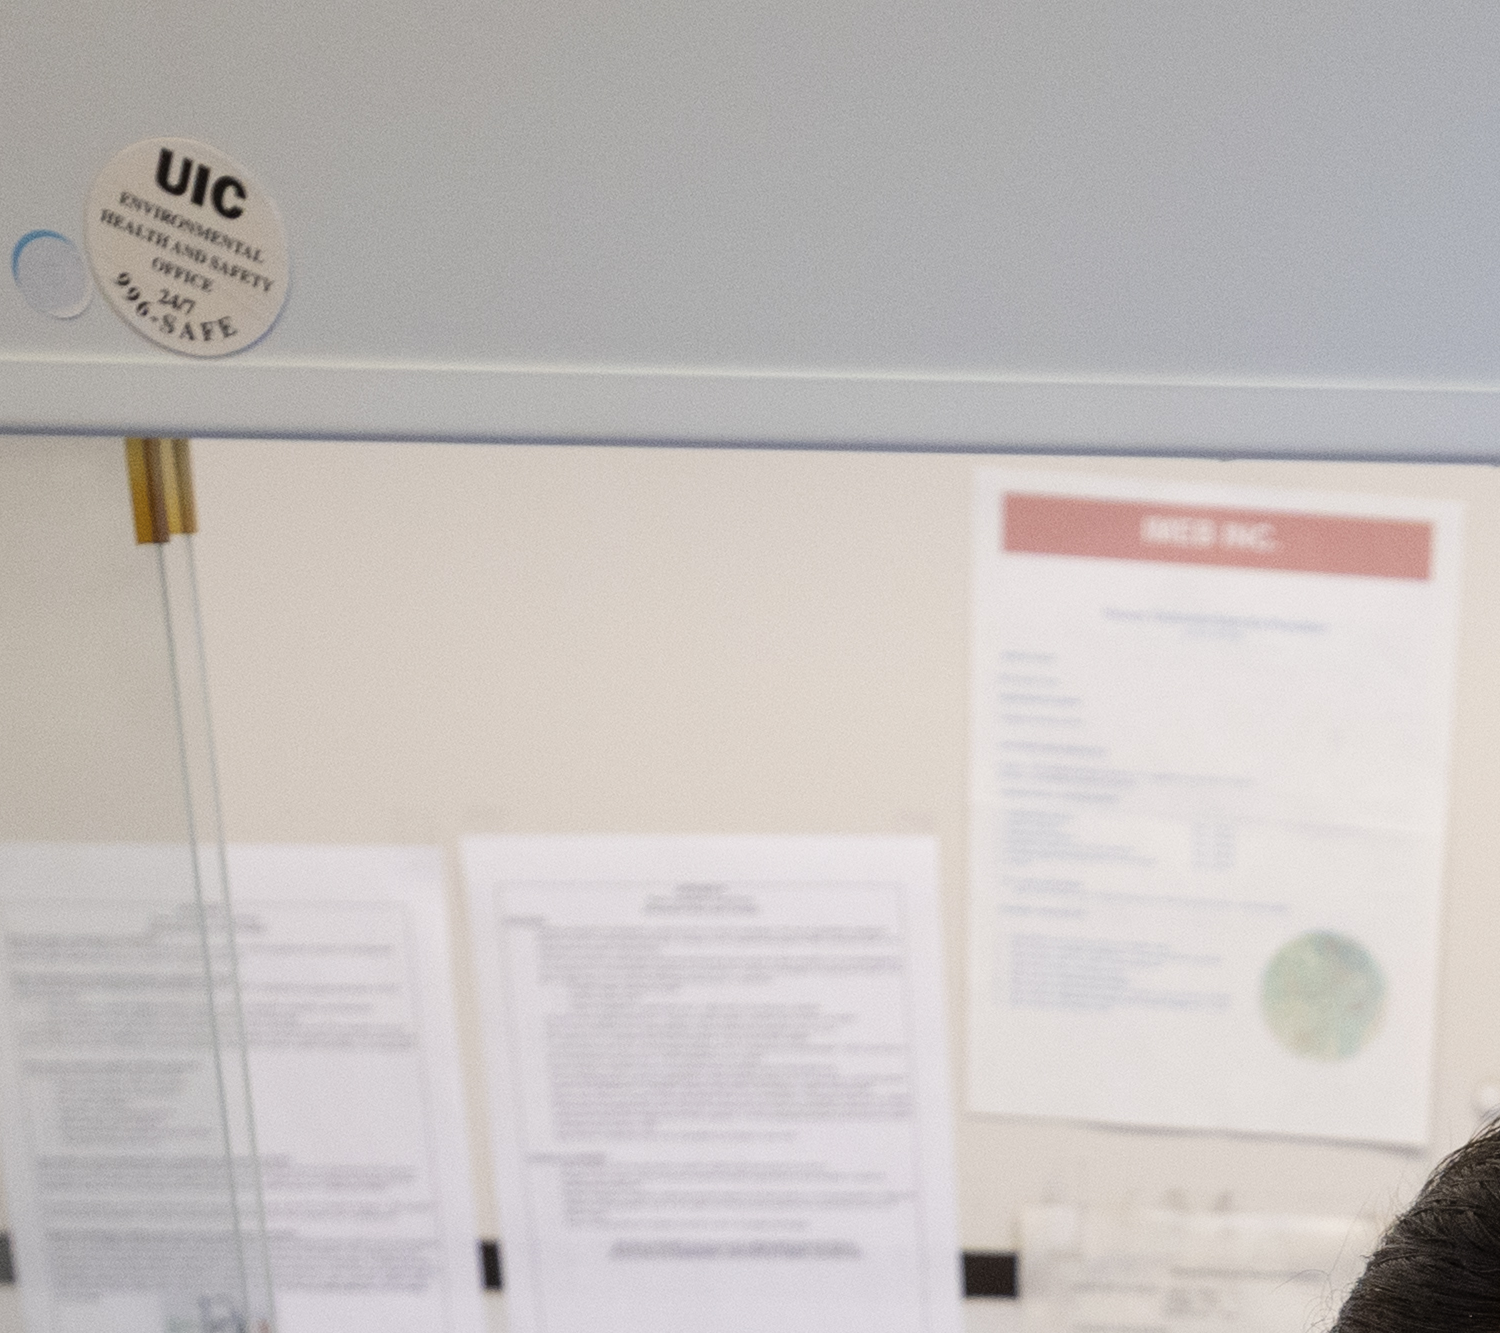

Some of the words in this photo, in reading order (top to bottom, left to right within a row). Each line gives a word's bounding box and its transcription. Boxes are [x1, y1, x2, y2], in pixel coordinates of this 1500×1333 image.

[155, 147, 247, 219] UIC
[100, 208, 169, 250] HEALTH
[171, 238, 208, 265] AND
[209, 254, 275, 293] SAFETY
[119, 191, 264, 264] ENVIRONMENTAL
[151, 256, 215, 293] OFFICE
[158, 288, 197, 315] 24/7
